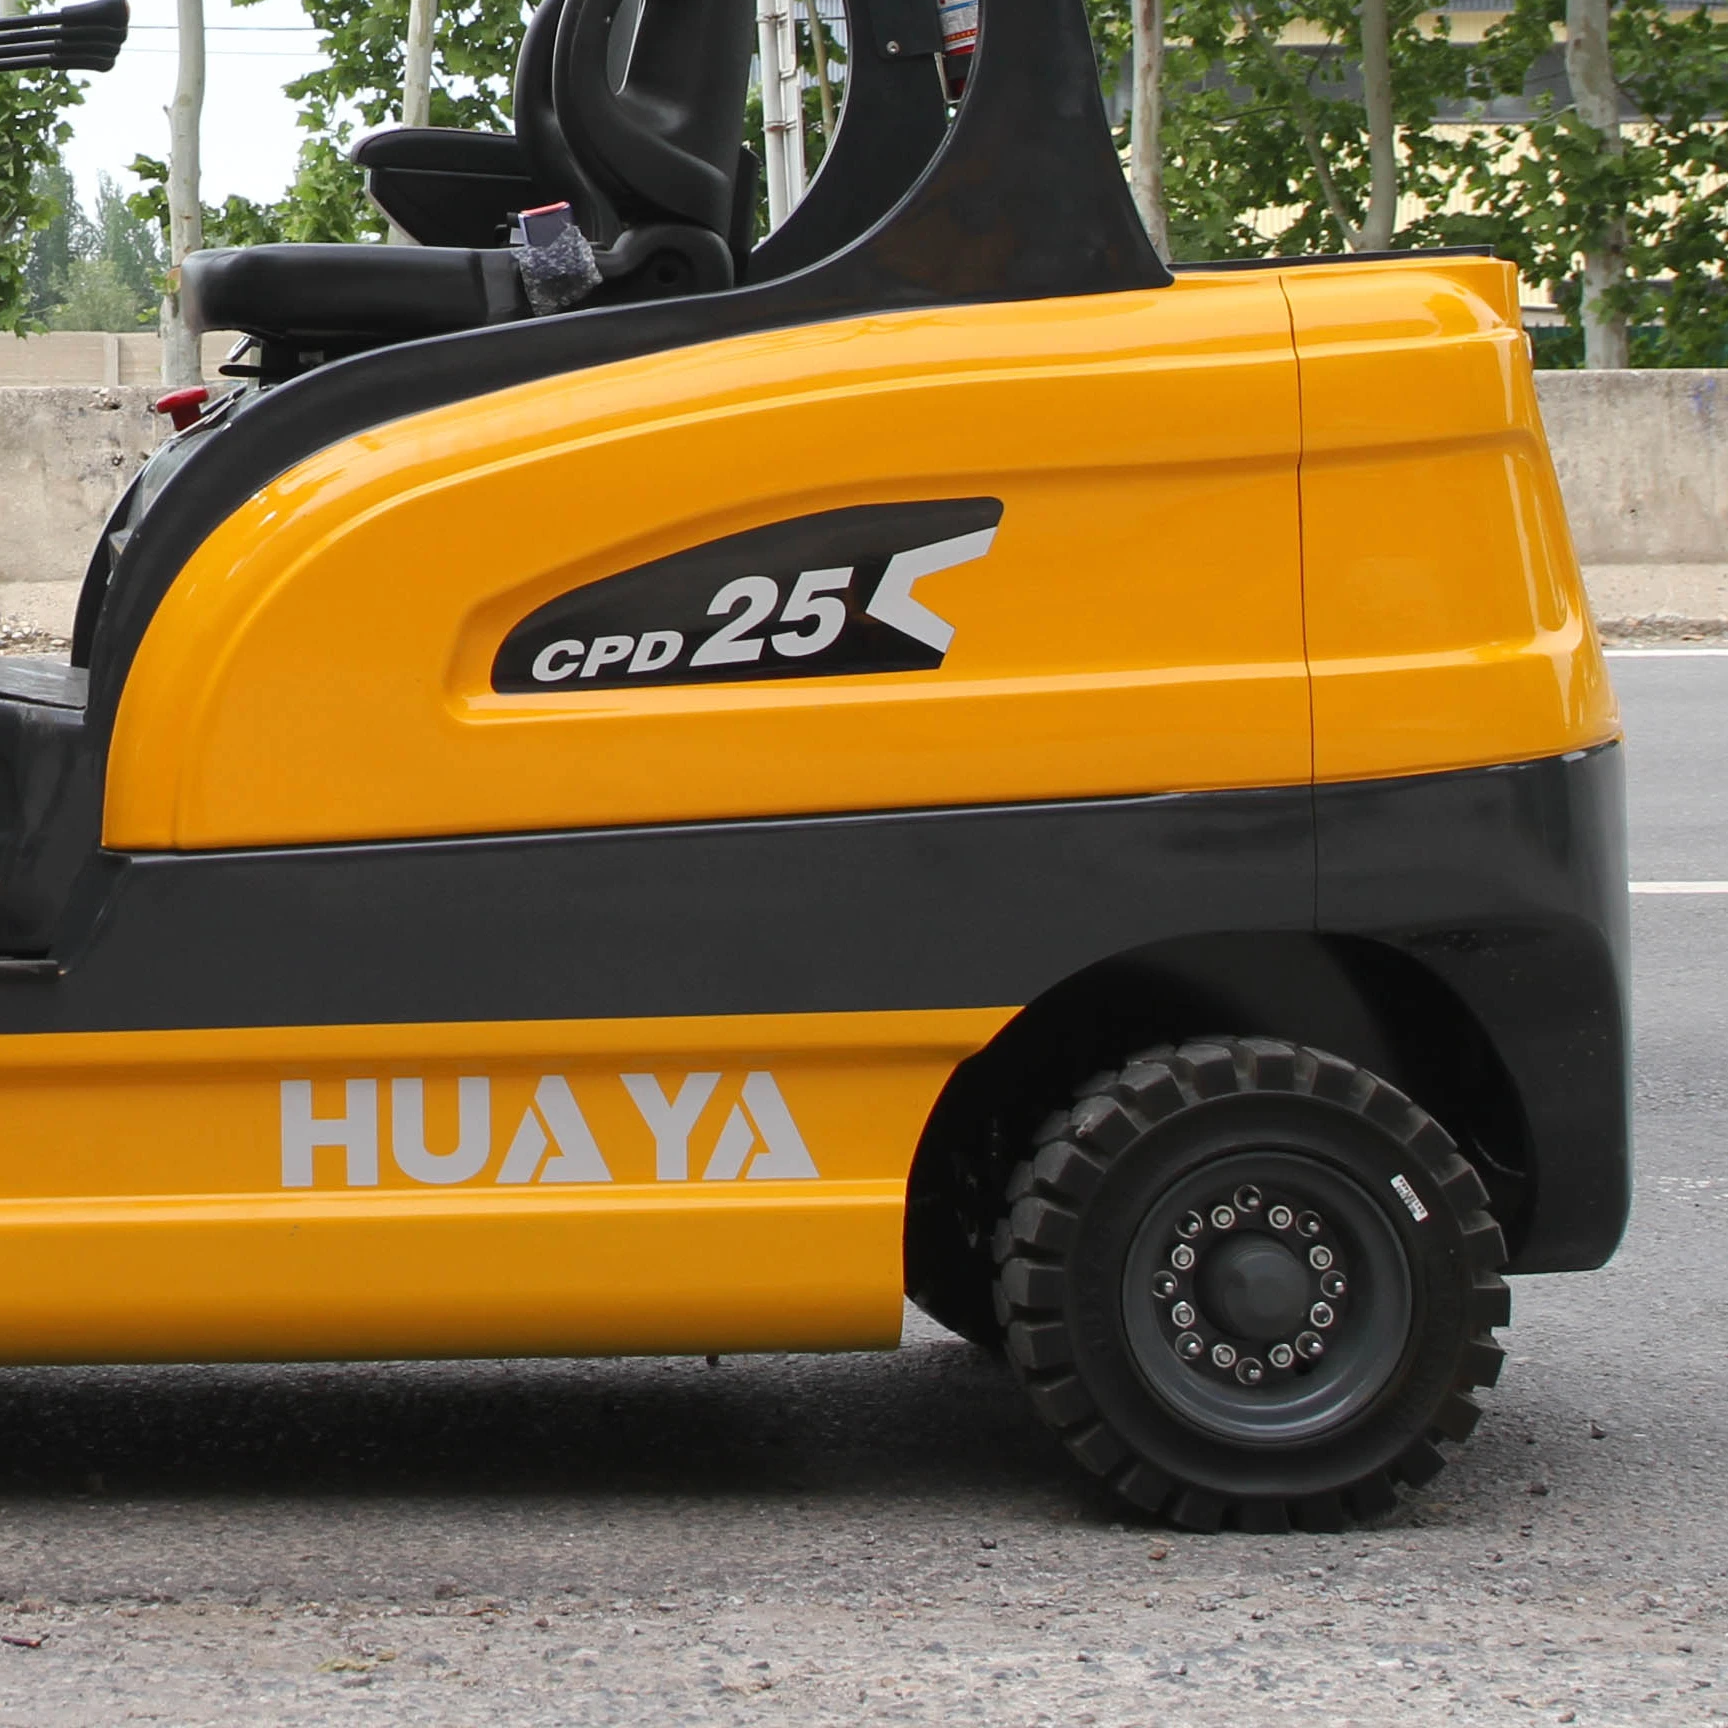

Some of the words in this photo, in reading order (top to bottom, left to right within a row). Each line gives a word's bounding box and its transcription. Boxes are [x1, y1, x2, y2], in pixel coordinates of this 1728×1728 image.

[531, 630, 684, 682] CPD
[688, 566, 855, 668] 25
[280, 1071, 821, 1187] HUAYA
